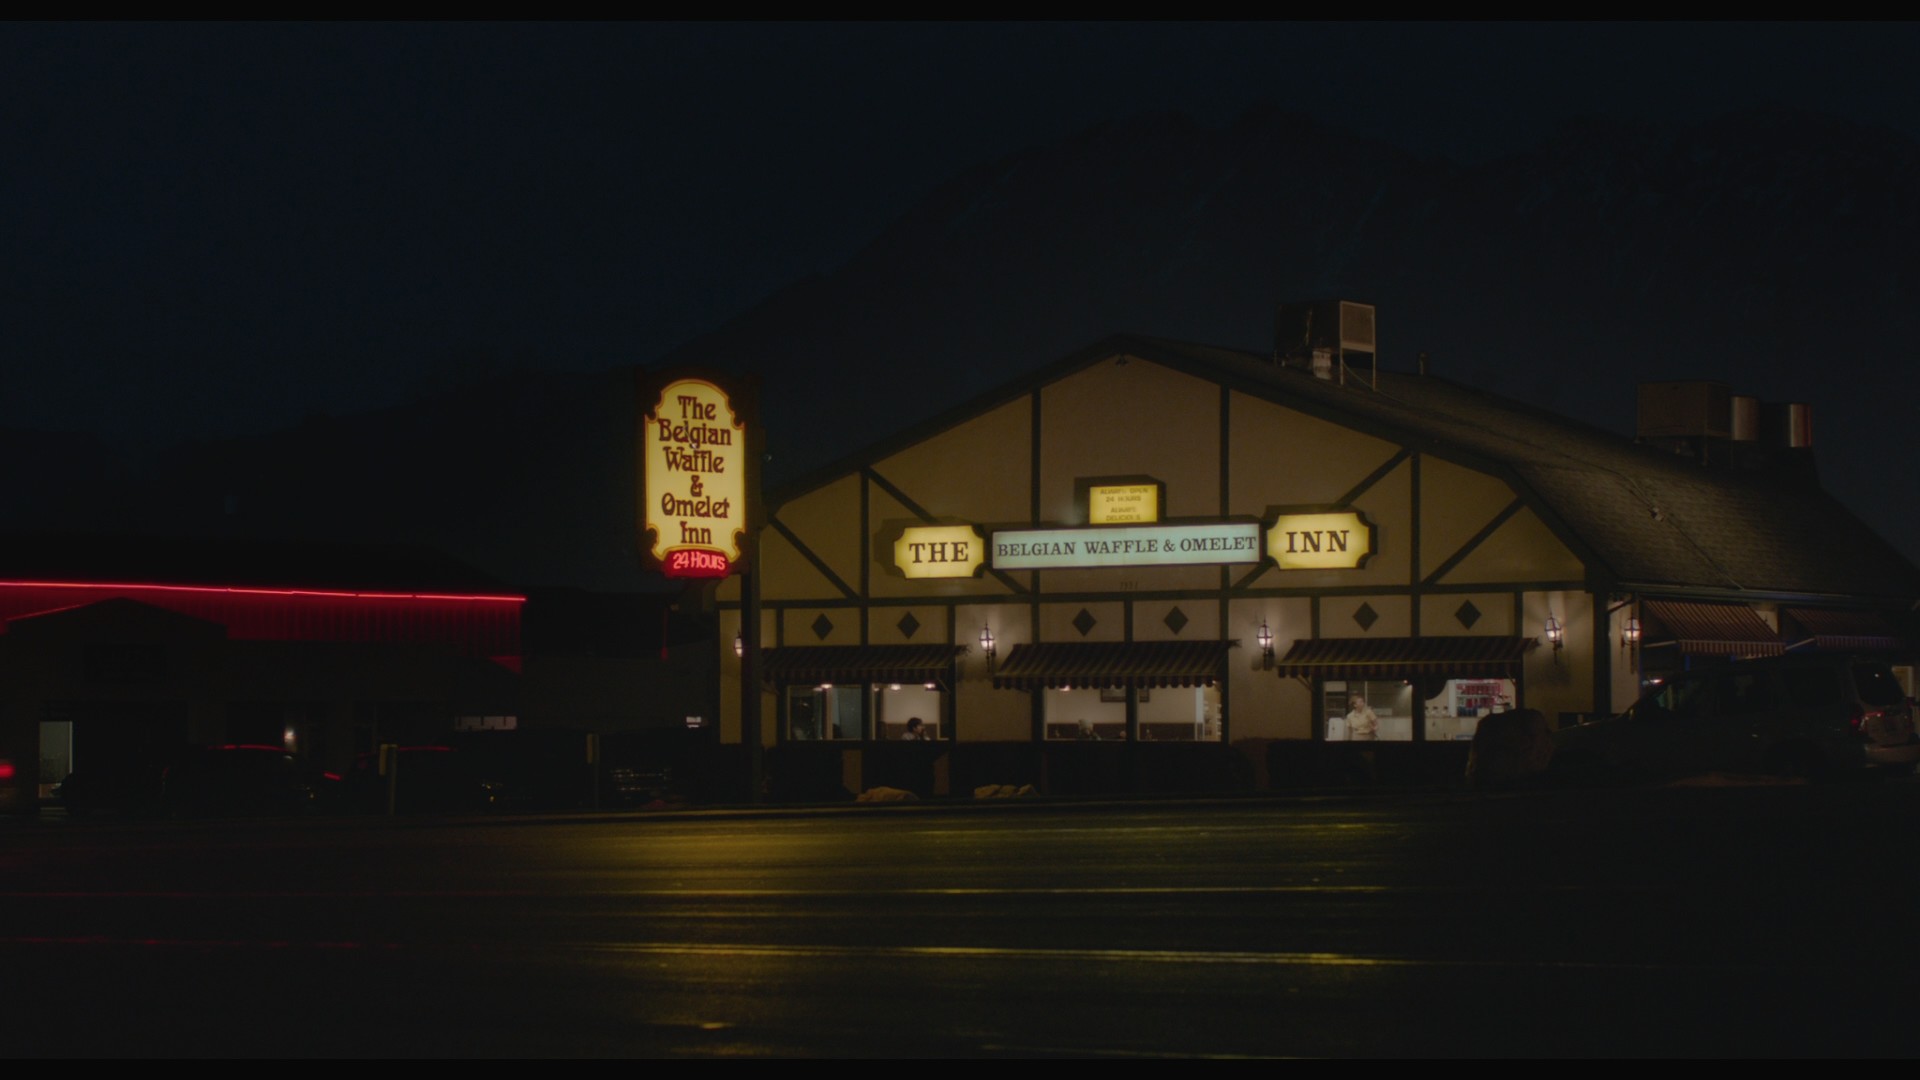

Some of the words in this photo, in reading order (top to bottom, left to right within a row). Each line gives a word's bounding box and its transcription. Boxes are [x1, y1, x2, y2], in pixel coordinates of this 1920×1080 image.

[677, 395, 716, 420] The
[658, 418, 732, 448] Belgian
[662, 446, 725, 473] Waffle
[690, 475, 703, 497] &
[661, 493, 730, 519] Omelet
[679, 521, 712, 545] Inn
[1286, 530, 1350, 553] INN
[909, 541, 969, 564] THE
[997, 542, 1076, 557] BELGIAN
[1084, 540, 1158, 555] WAFFLE
[1163, 539, 1176, 552] &
[1180, 537, 1257, 552] OMELET
[673, 552, 689, 570] 24
[691, 551, 726, 571] Hours
